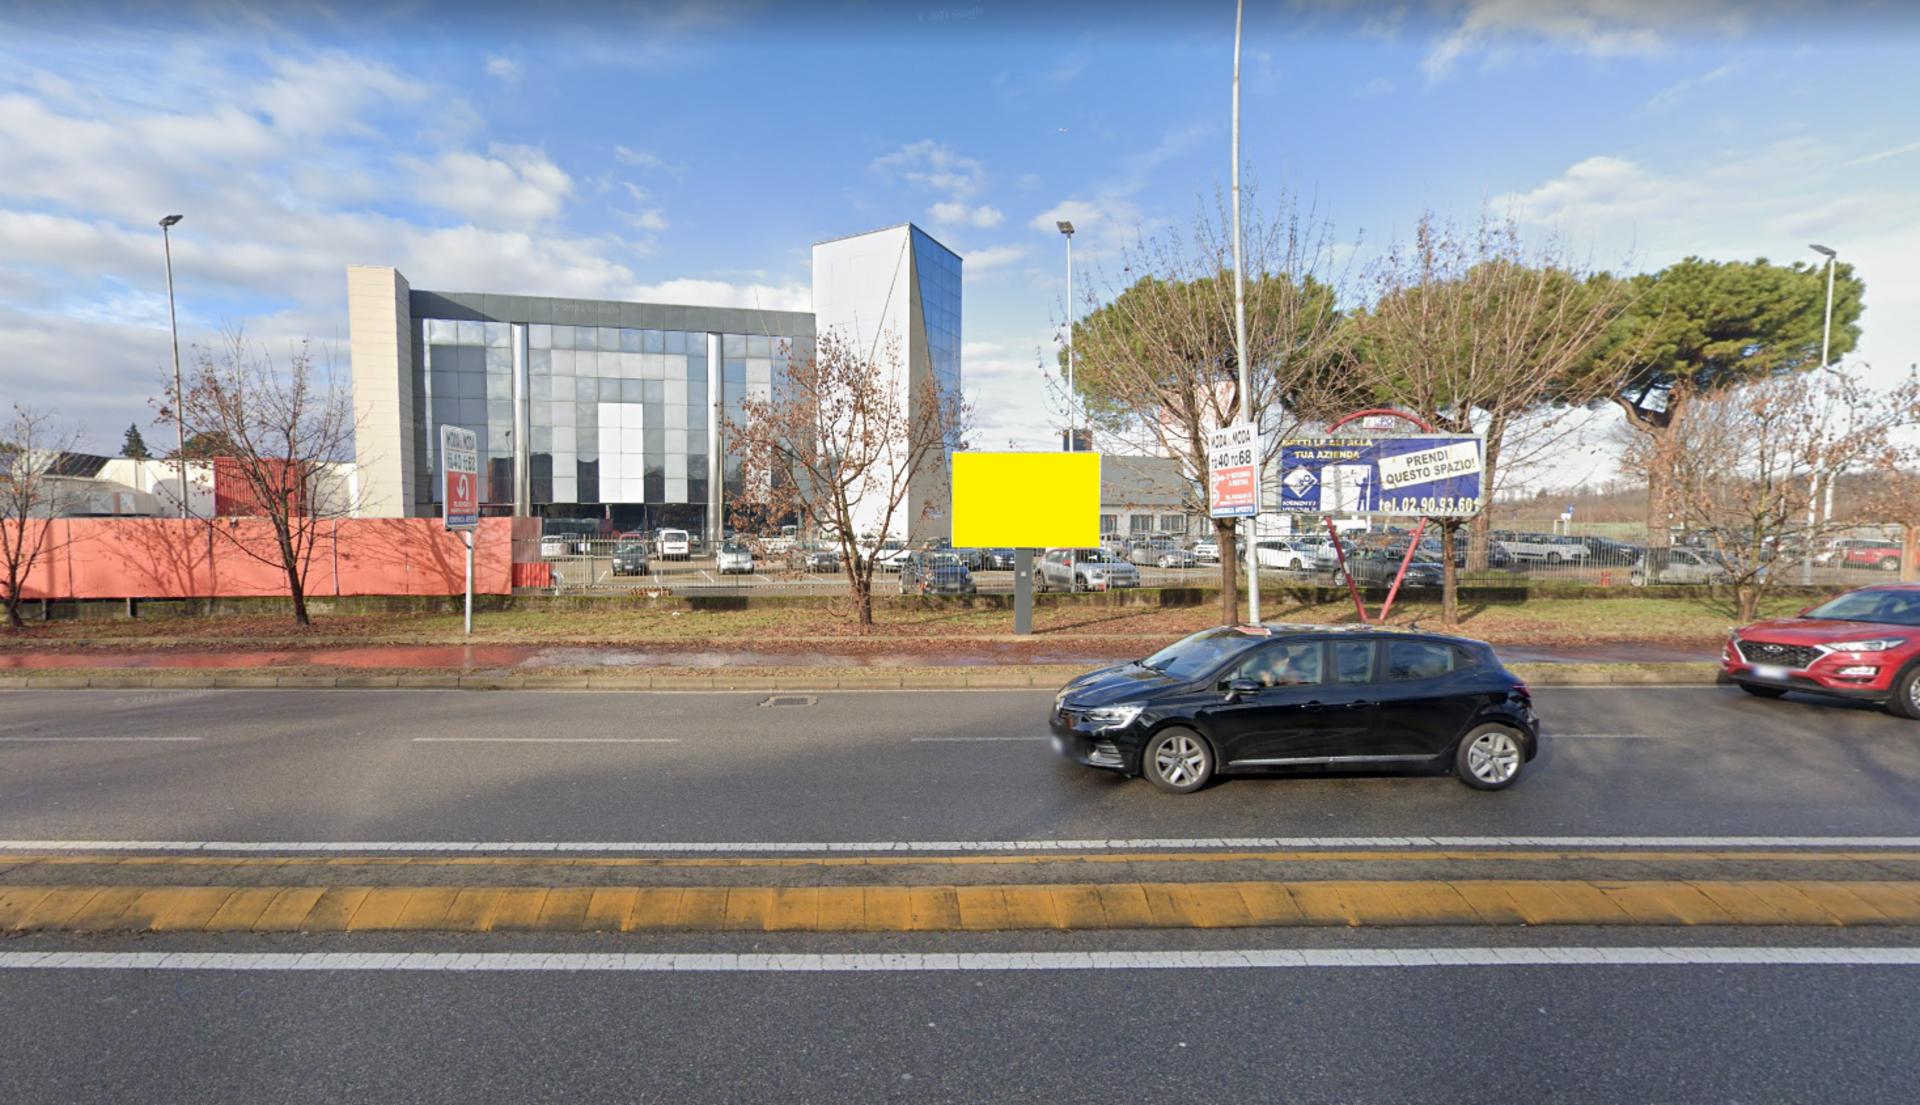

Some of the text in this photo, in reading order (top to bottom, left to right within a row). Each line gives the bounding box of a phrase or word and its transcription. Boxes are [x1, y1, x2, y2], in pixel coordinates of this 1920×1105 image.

[1232, 430, 1250, 444] MODA
[1406, 450, 1448, 466] PRENDI
[1386, 458, 1475, 484] QUESTO SPAZIO!
